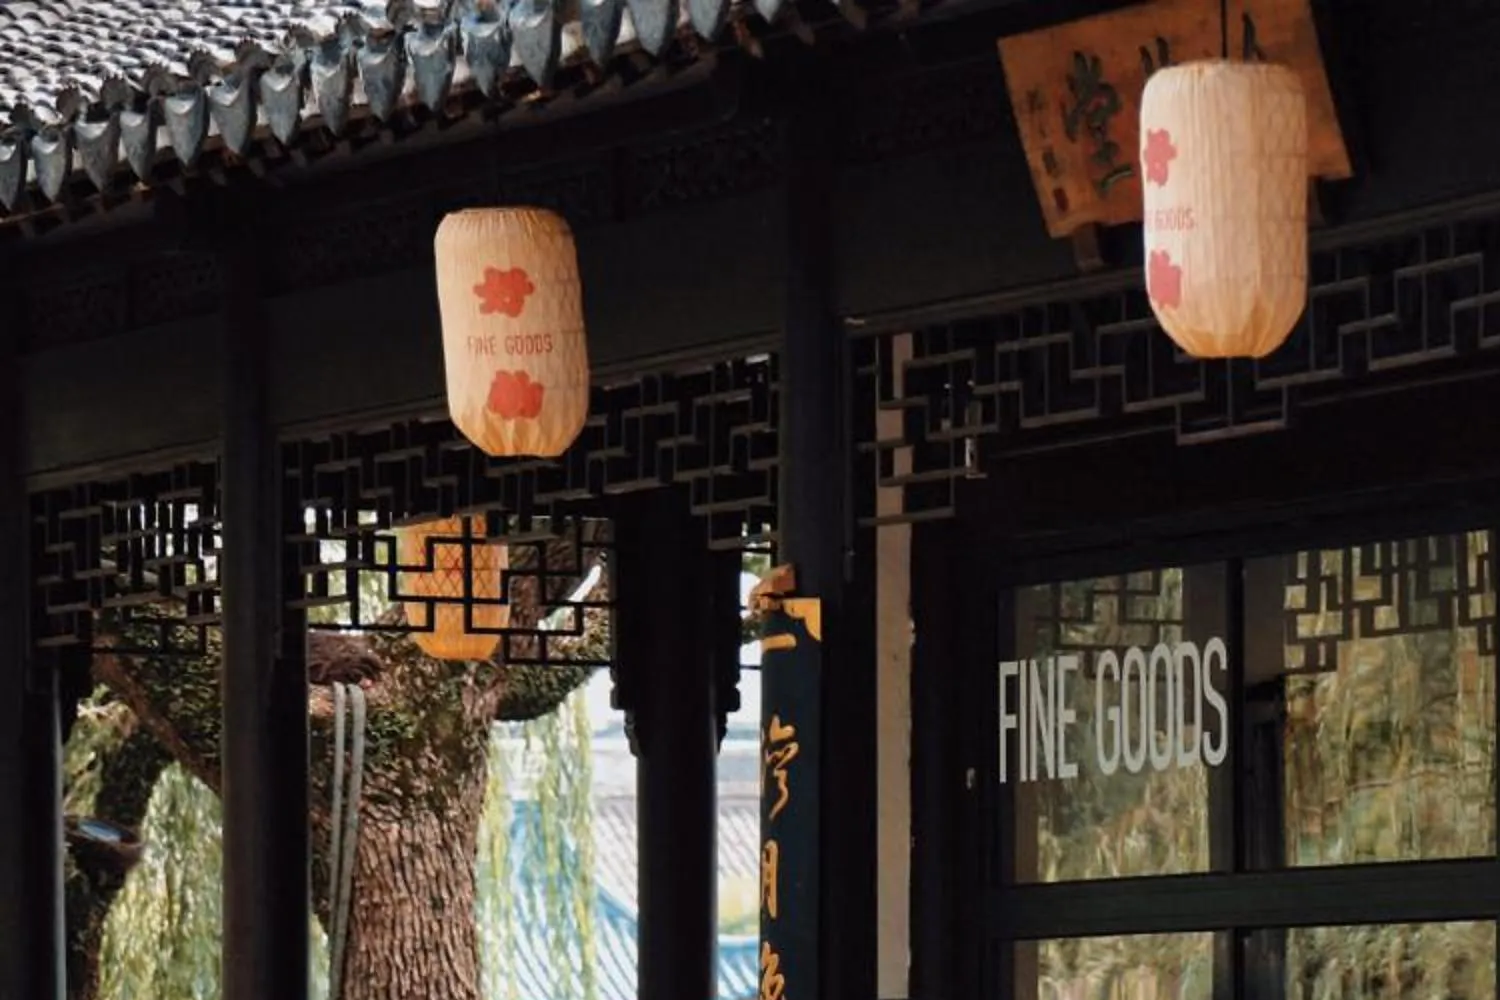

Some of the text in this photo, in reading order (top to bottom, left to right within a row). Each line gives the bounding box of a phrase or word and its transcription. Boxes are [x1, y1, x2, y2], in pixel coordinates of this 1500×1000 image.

[467, 333, 554, 356] FINE GOODS
[998, 636, 1228, 784] FINE GOODS
